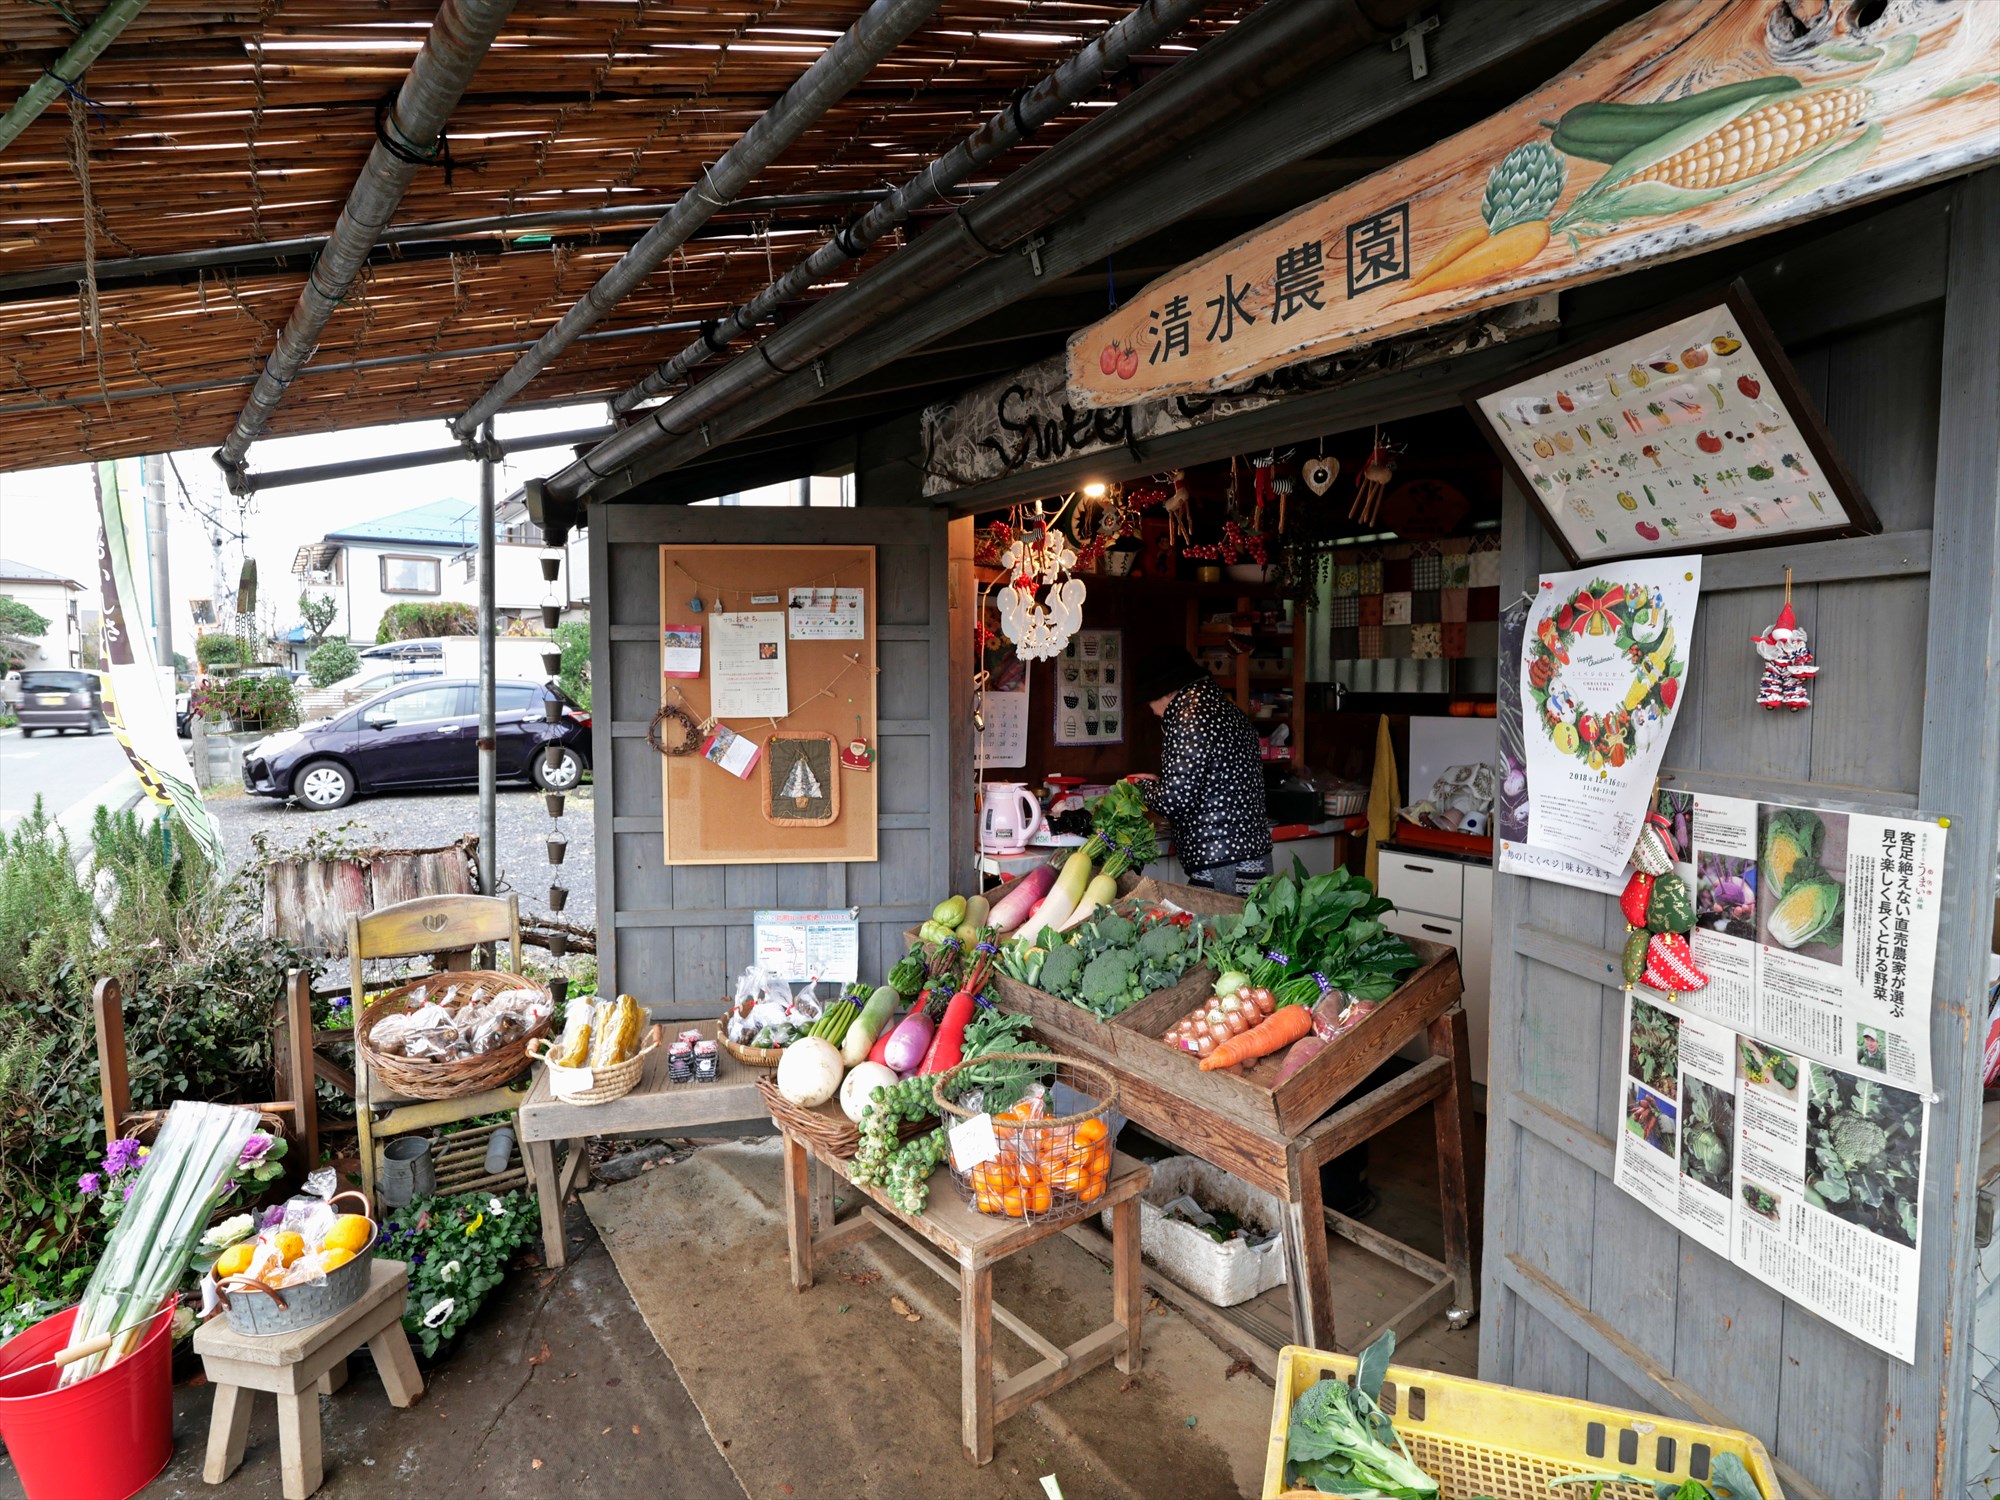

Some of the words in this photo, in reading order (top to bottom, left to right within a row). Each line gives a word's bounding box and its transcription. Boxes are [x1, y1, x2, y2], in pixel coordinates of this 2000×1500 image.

[1147, 201, 1410, 367] 清水農園
[1726, 330, 1735, 338] あ
[1873, 828, 1897, 1001] 見て楽しく長くとれる野菜
[1889, 831, 1916, 1018] 客足絶えない直売農家が選ぶ
